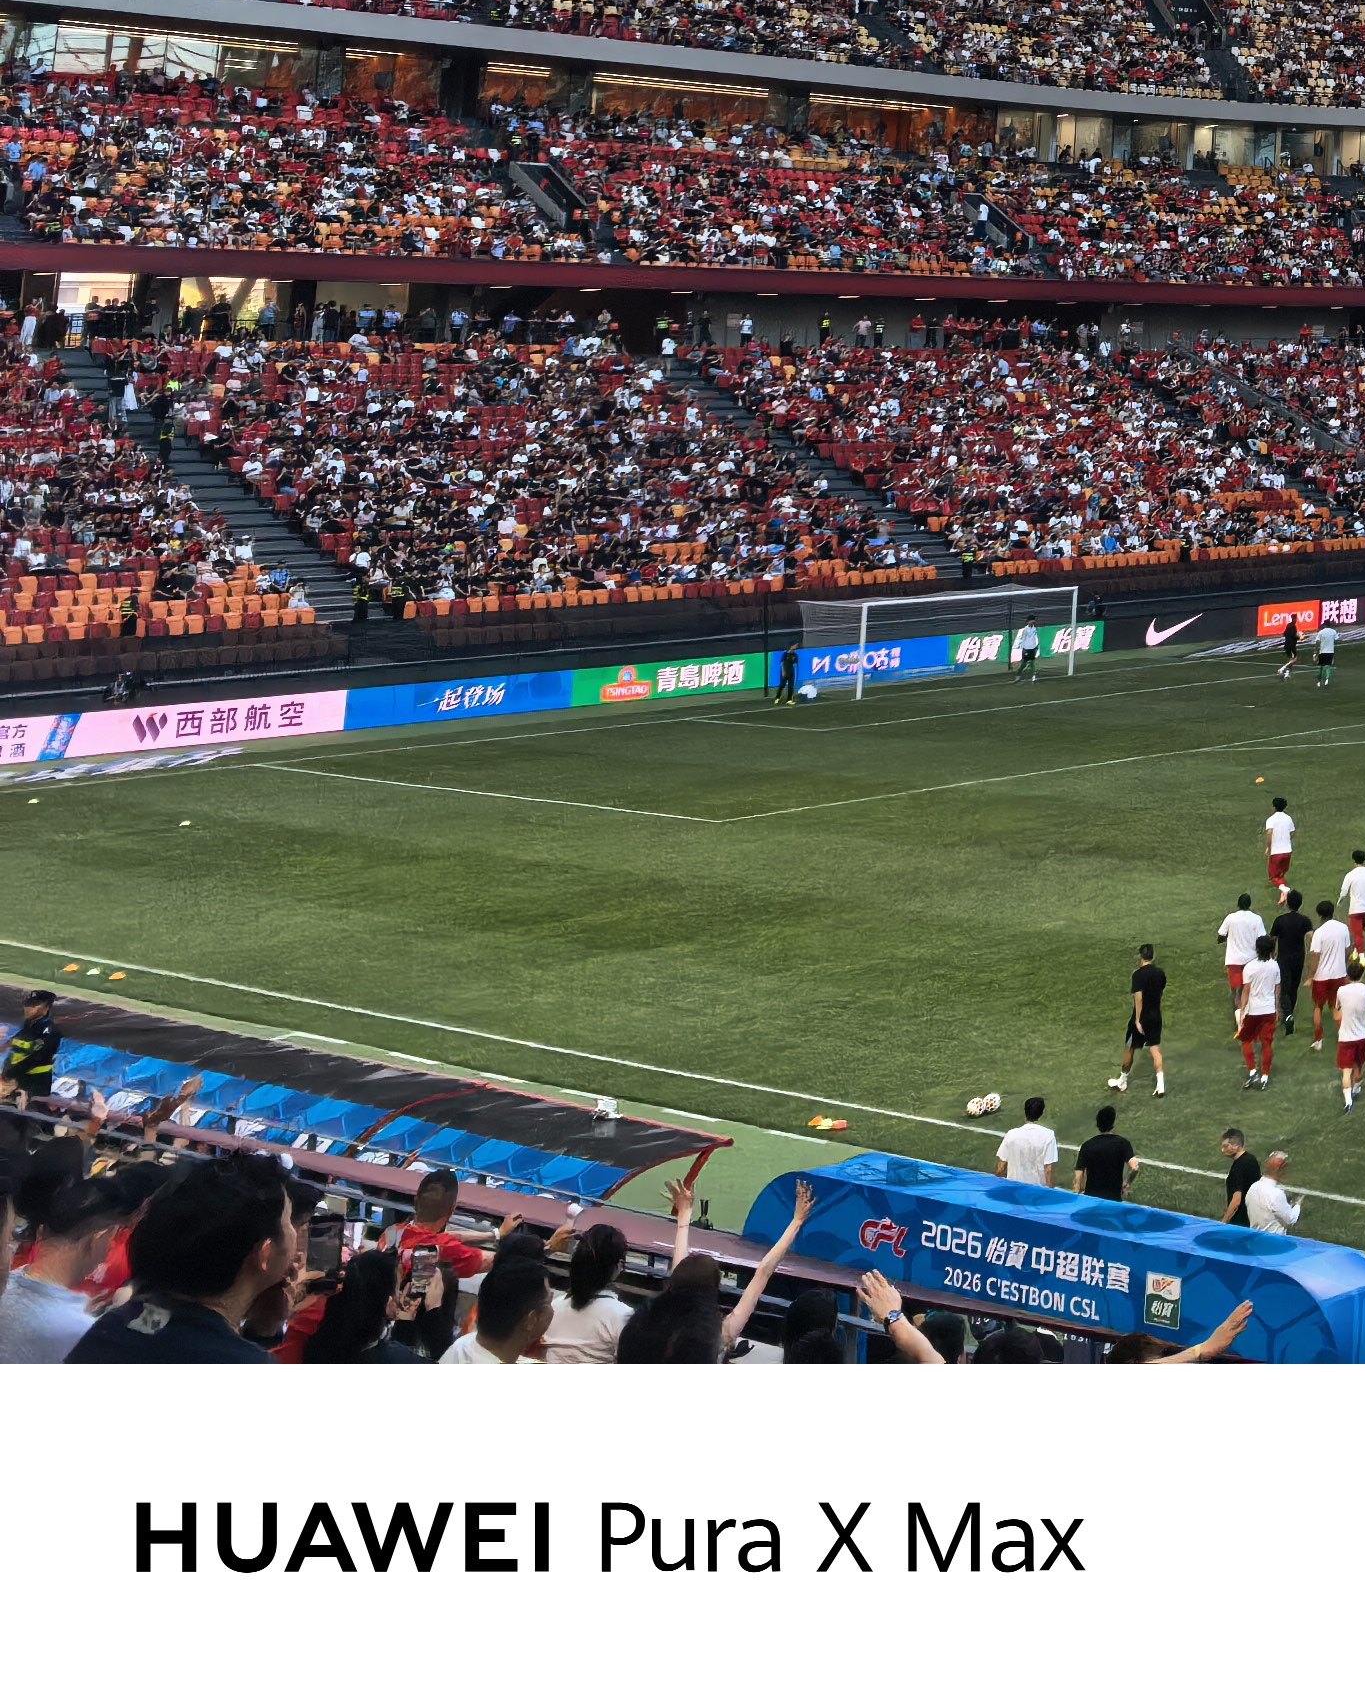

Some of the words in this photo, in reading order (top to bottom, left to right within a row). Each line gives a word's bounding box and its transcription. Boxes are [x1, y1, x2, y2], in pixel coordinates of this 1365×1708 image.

[1321, 599, 1357, 624] 联想
[604, 684, 649, 698] TSINGTAO
[657, 660, 744, 692] 青岛啤酒
[175, 701, 306, 739] 西部航空
[921, 1220, 983, 1259] 2026
[985, 1237, 1028, 1270] 怡寶
[1031, 1246, 1131, 1293] 中超联赛
[943, 1267, 982, 1292] 2026
[985, 1276, 1065, 1312] C'ESTBON
[1069, 1296, 1100, 1321] CSL
